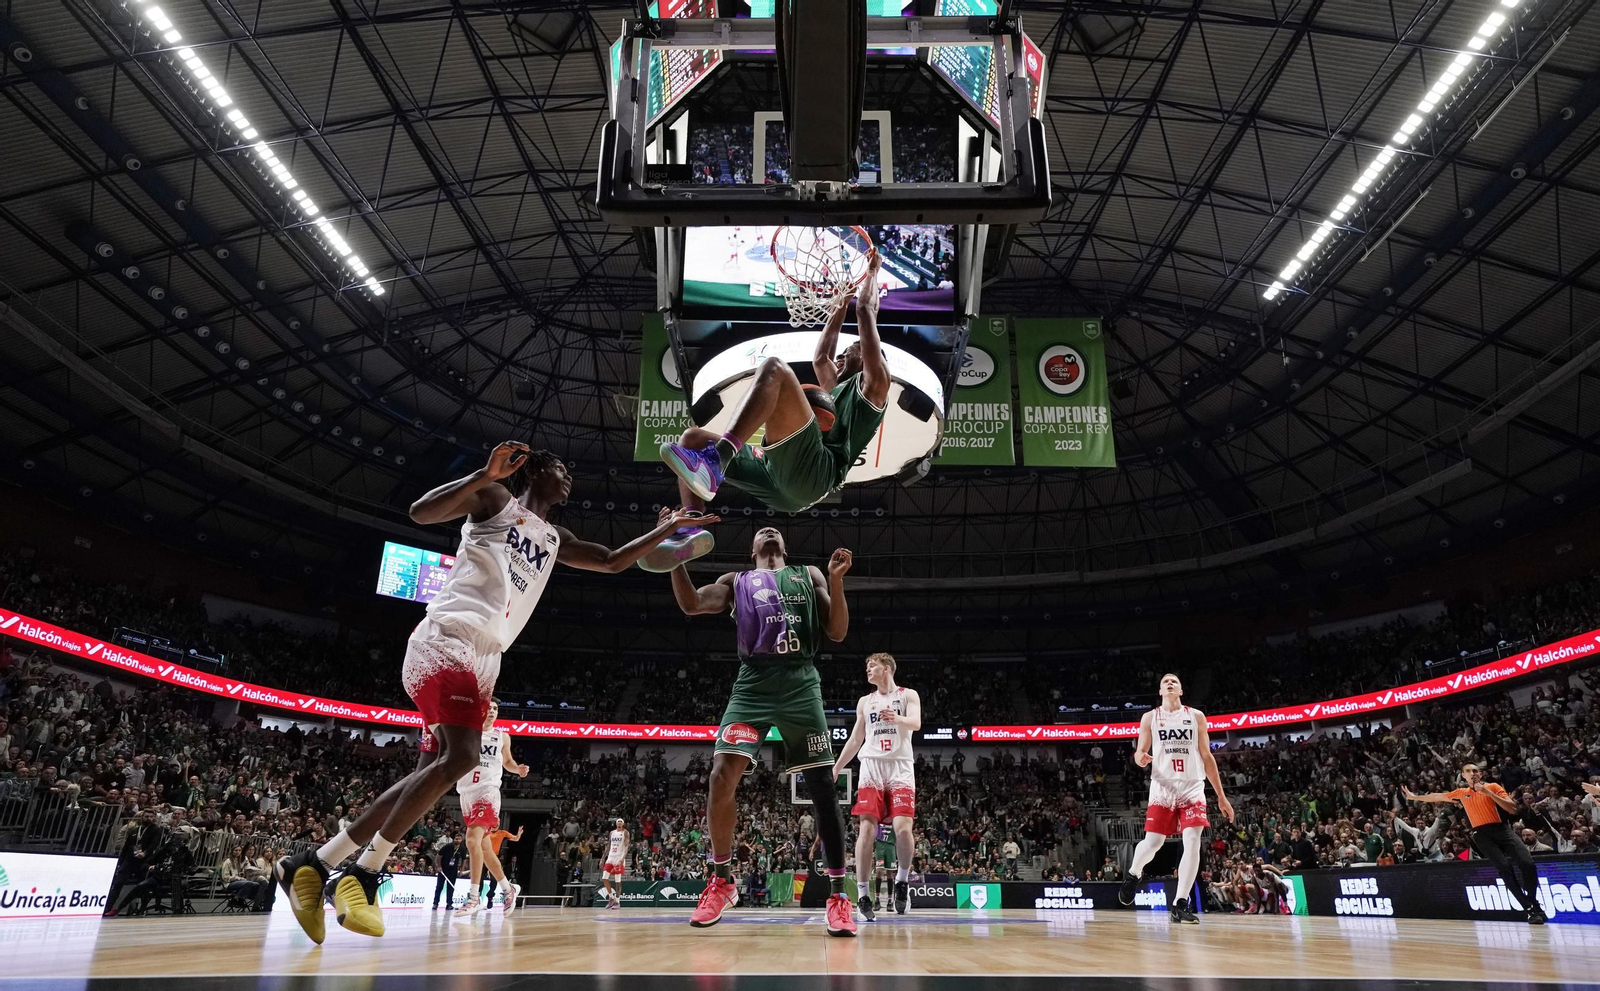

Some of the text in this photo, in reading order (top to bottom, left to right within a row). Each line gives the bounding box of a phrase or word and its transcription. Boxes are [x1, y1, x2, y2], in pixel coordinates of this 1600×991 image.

[1024, 406, 1107, 424] CAMPEONES
[644, 418, 677, 428] COPA
[1024, 424, 1110, 434] COPA DEL REY
[942, 437, 995, 448] 2016/2017
[1055, 440, 1082, 450] 2023
[17, 622, 82, 652] Halcón viajes
[776, 630, 801, 654] 55
[1534, 643, 1595, 666] Halcón viajes
[101, 648, 139, 669] Halcón
[138, 662, 156, 674] viajes
[172, 669, 223, 692] Halcón viajes
[1464, 667, 1516, 686] Halcón viajes
[241, 688, 295, 707] Halcón viajes
[1393, 686, 1447, 702] Halcón viajes
[314, 701, 368, 718] Halcón viajes
[1321, 701, 1376, 715] Halcón viajes
[387, 712, 423, 724] Halcón
[1249, 712, 1285, 725] Halcón
[528, 724, 561, 734] Halcón
[595, 726, 627, 736] Halcón
[659, 728, 692, 737] Halcón
[832, 728, 848, 740] 53
[873, 728, 897, 736] MANRESA
[977, 729, 1010, 738] Halcón
[1042, 727, 1092, 738] Halcón viajes
[1158, 729, 1193, 740] BAXI
[880, 740, 892, 751] 12
[1171, 759, 1184, 772] 19
[472, 771, 480, 783] 6
[1044, 887, 1083, 897] REDES
[1340, 877, 1379, 895] REDES
[1, 887, 66, 913] Unicaja
[391, 893, 425, 906] Unicaja Banco
[676, 892, 698, 900] Unicaja
[1035, 898, 1094, 909] SOCIALES
[1334, 897, 1394, 916] SOCIALES
